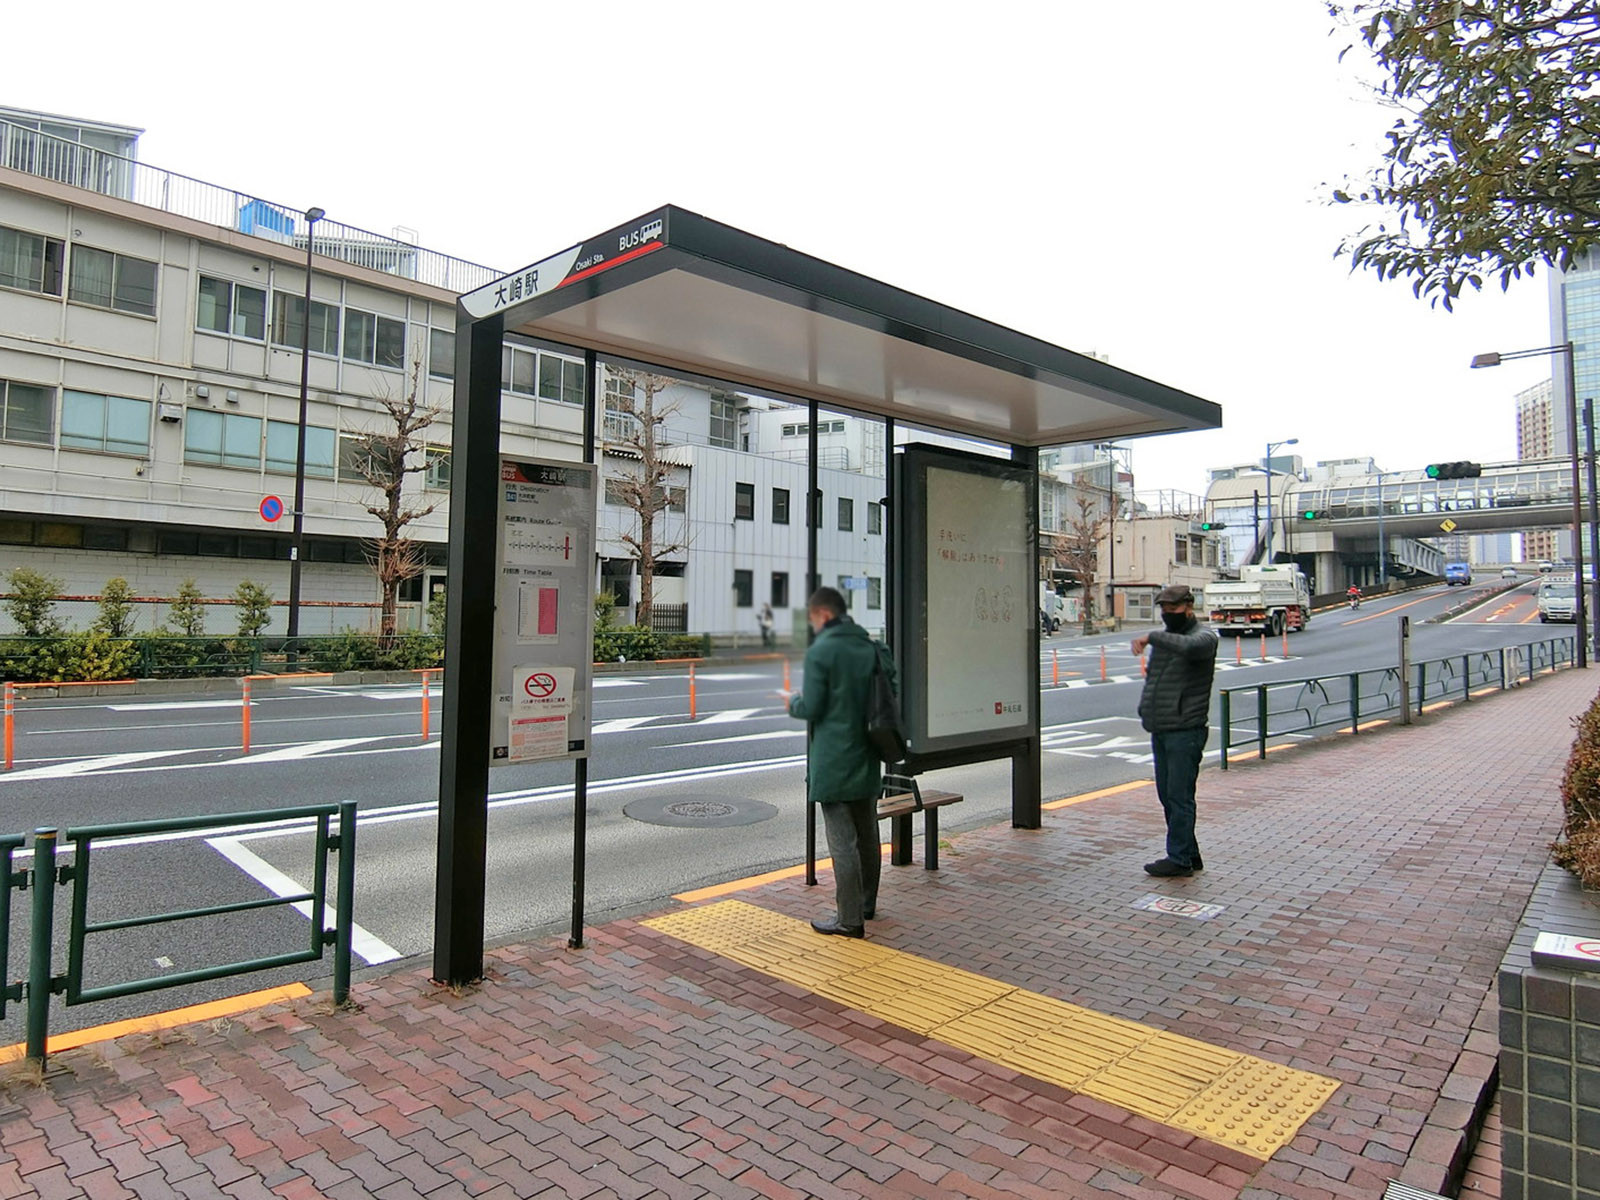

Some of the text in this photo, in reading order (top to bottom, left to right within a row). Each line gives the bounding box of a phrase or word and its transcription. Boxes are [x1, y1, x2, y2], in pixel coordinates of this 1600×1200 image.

[619, 230, 639, 251] BUS
[575, 254, 605, 271] Osaki Sta.
[494, 269, 539, 309] 大崎駅
